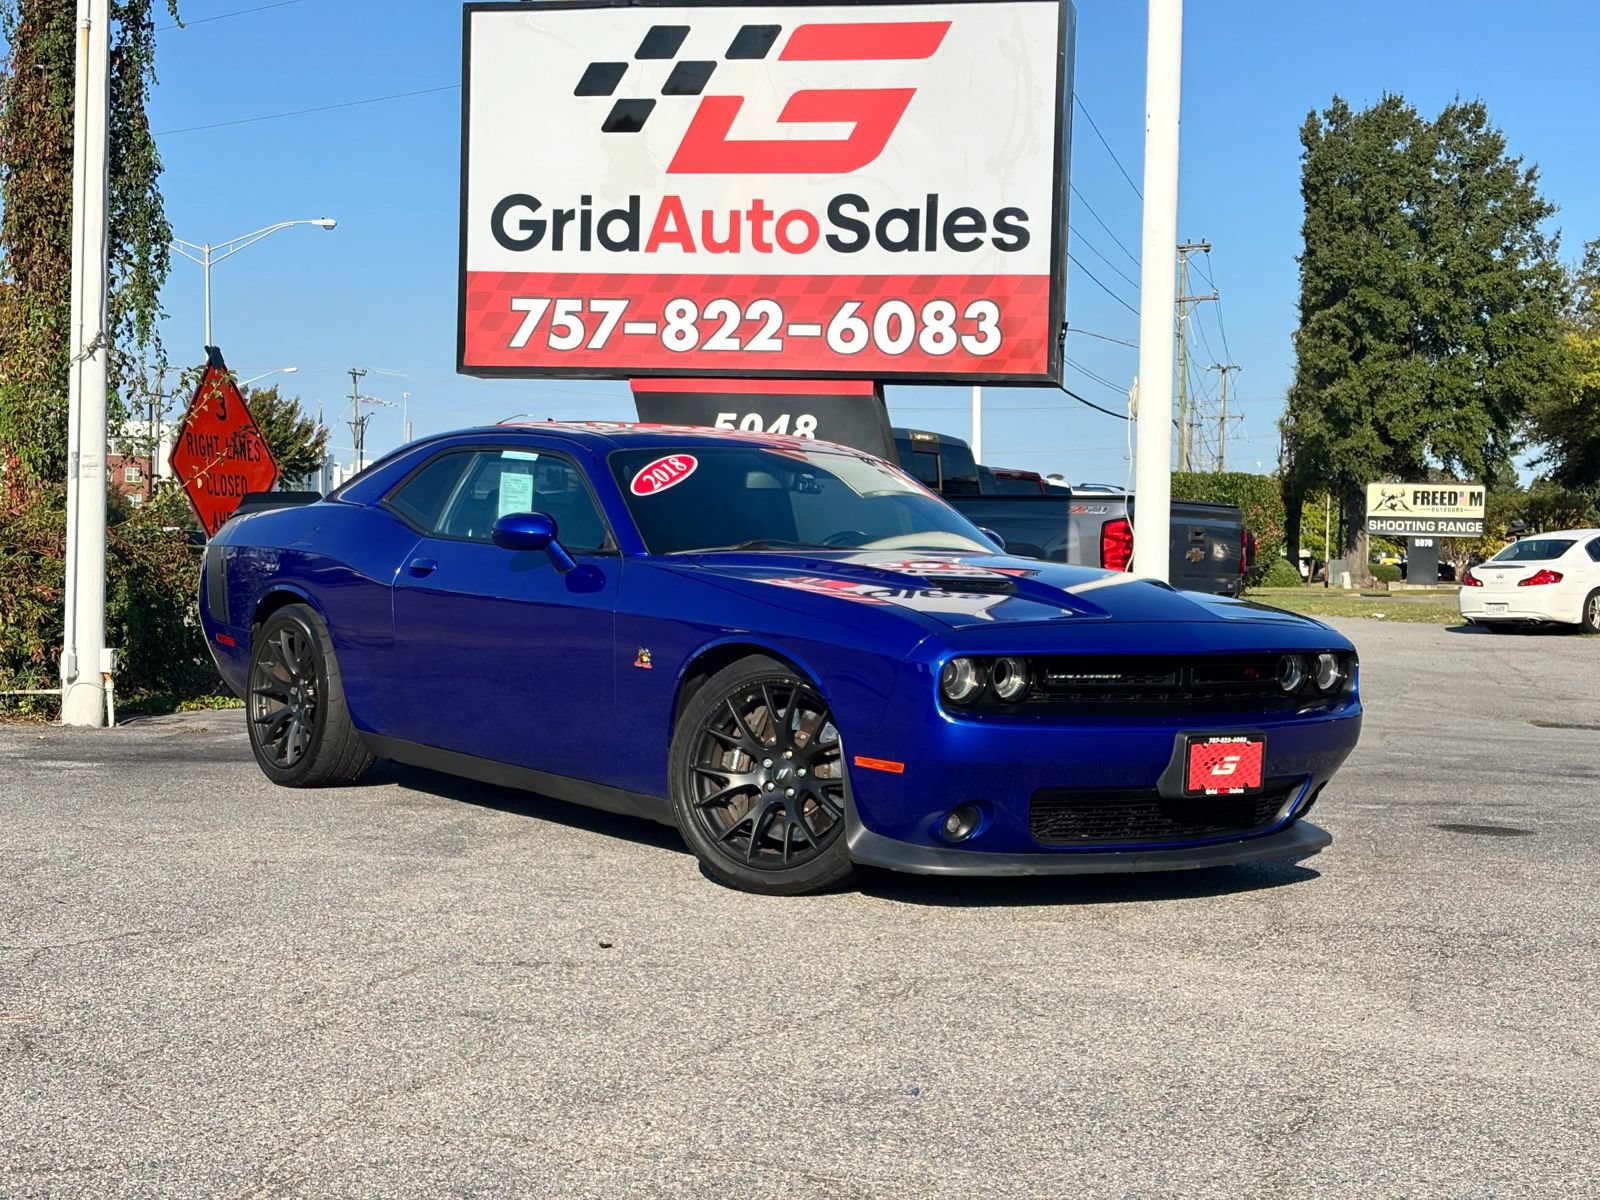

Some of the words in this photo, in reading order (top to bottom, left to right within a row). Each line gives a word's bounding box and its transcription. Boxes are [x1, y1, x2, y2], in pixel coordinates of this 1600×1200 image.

[490, 193, 1031, 254] GridAutoSales
[508, 298, 1002, 356] 757-822-6083
[714, 412, 818, 440] 5048
[186, 432, 219, 459] RIGHT
[225, 436, 261, 463] LANES
[206, 473, 248, 498] CLOSED
[643, 457, 688, 490] 2018
[1412, 490, 1483, 507] FREEDM
[1368, 520, 1436, 532] SHOOTING
[1438, 521, 1484, 533] RANGE
